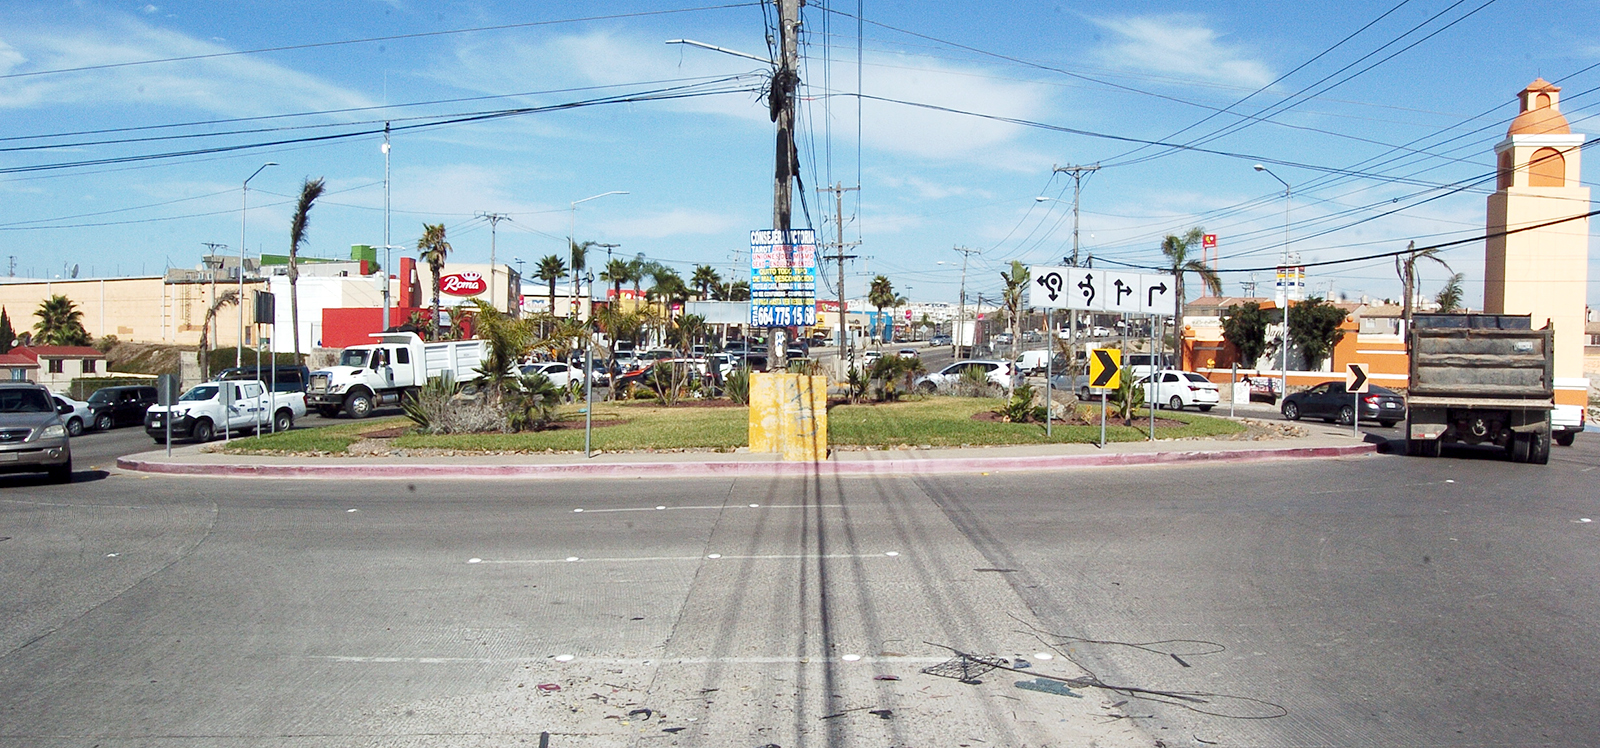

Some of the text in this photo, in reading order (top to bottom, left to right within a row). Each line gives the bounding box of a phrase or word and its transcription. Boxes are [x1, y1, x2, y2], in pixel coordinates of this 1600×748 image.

[443, 275, 479, 291] Roma
[758, 306, 773, 325] 664
[775, 306, 790, 325] 775
[792, 306, 803, 325] 15
[804, 306, 815, 325] 68
